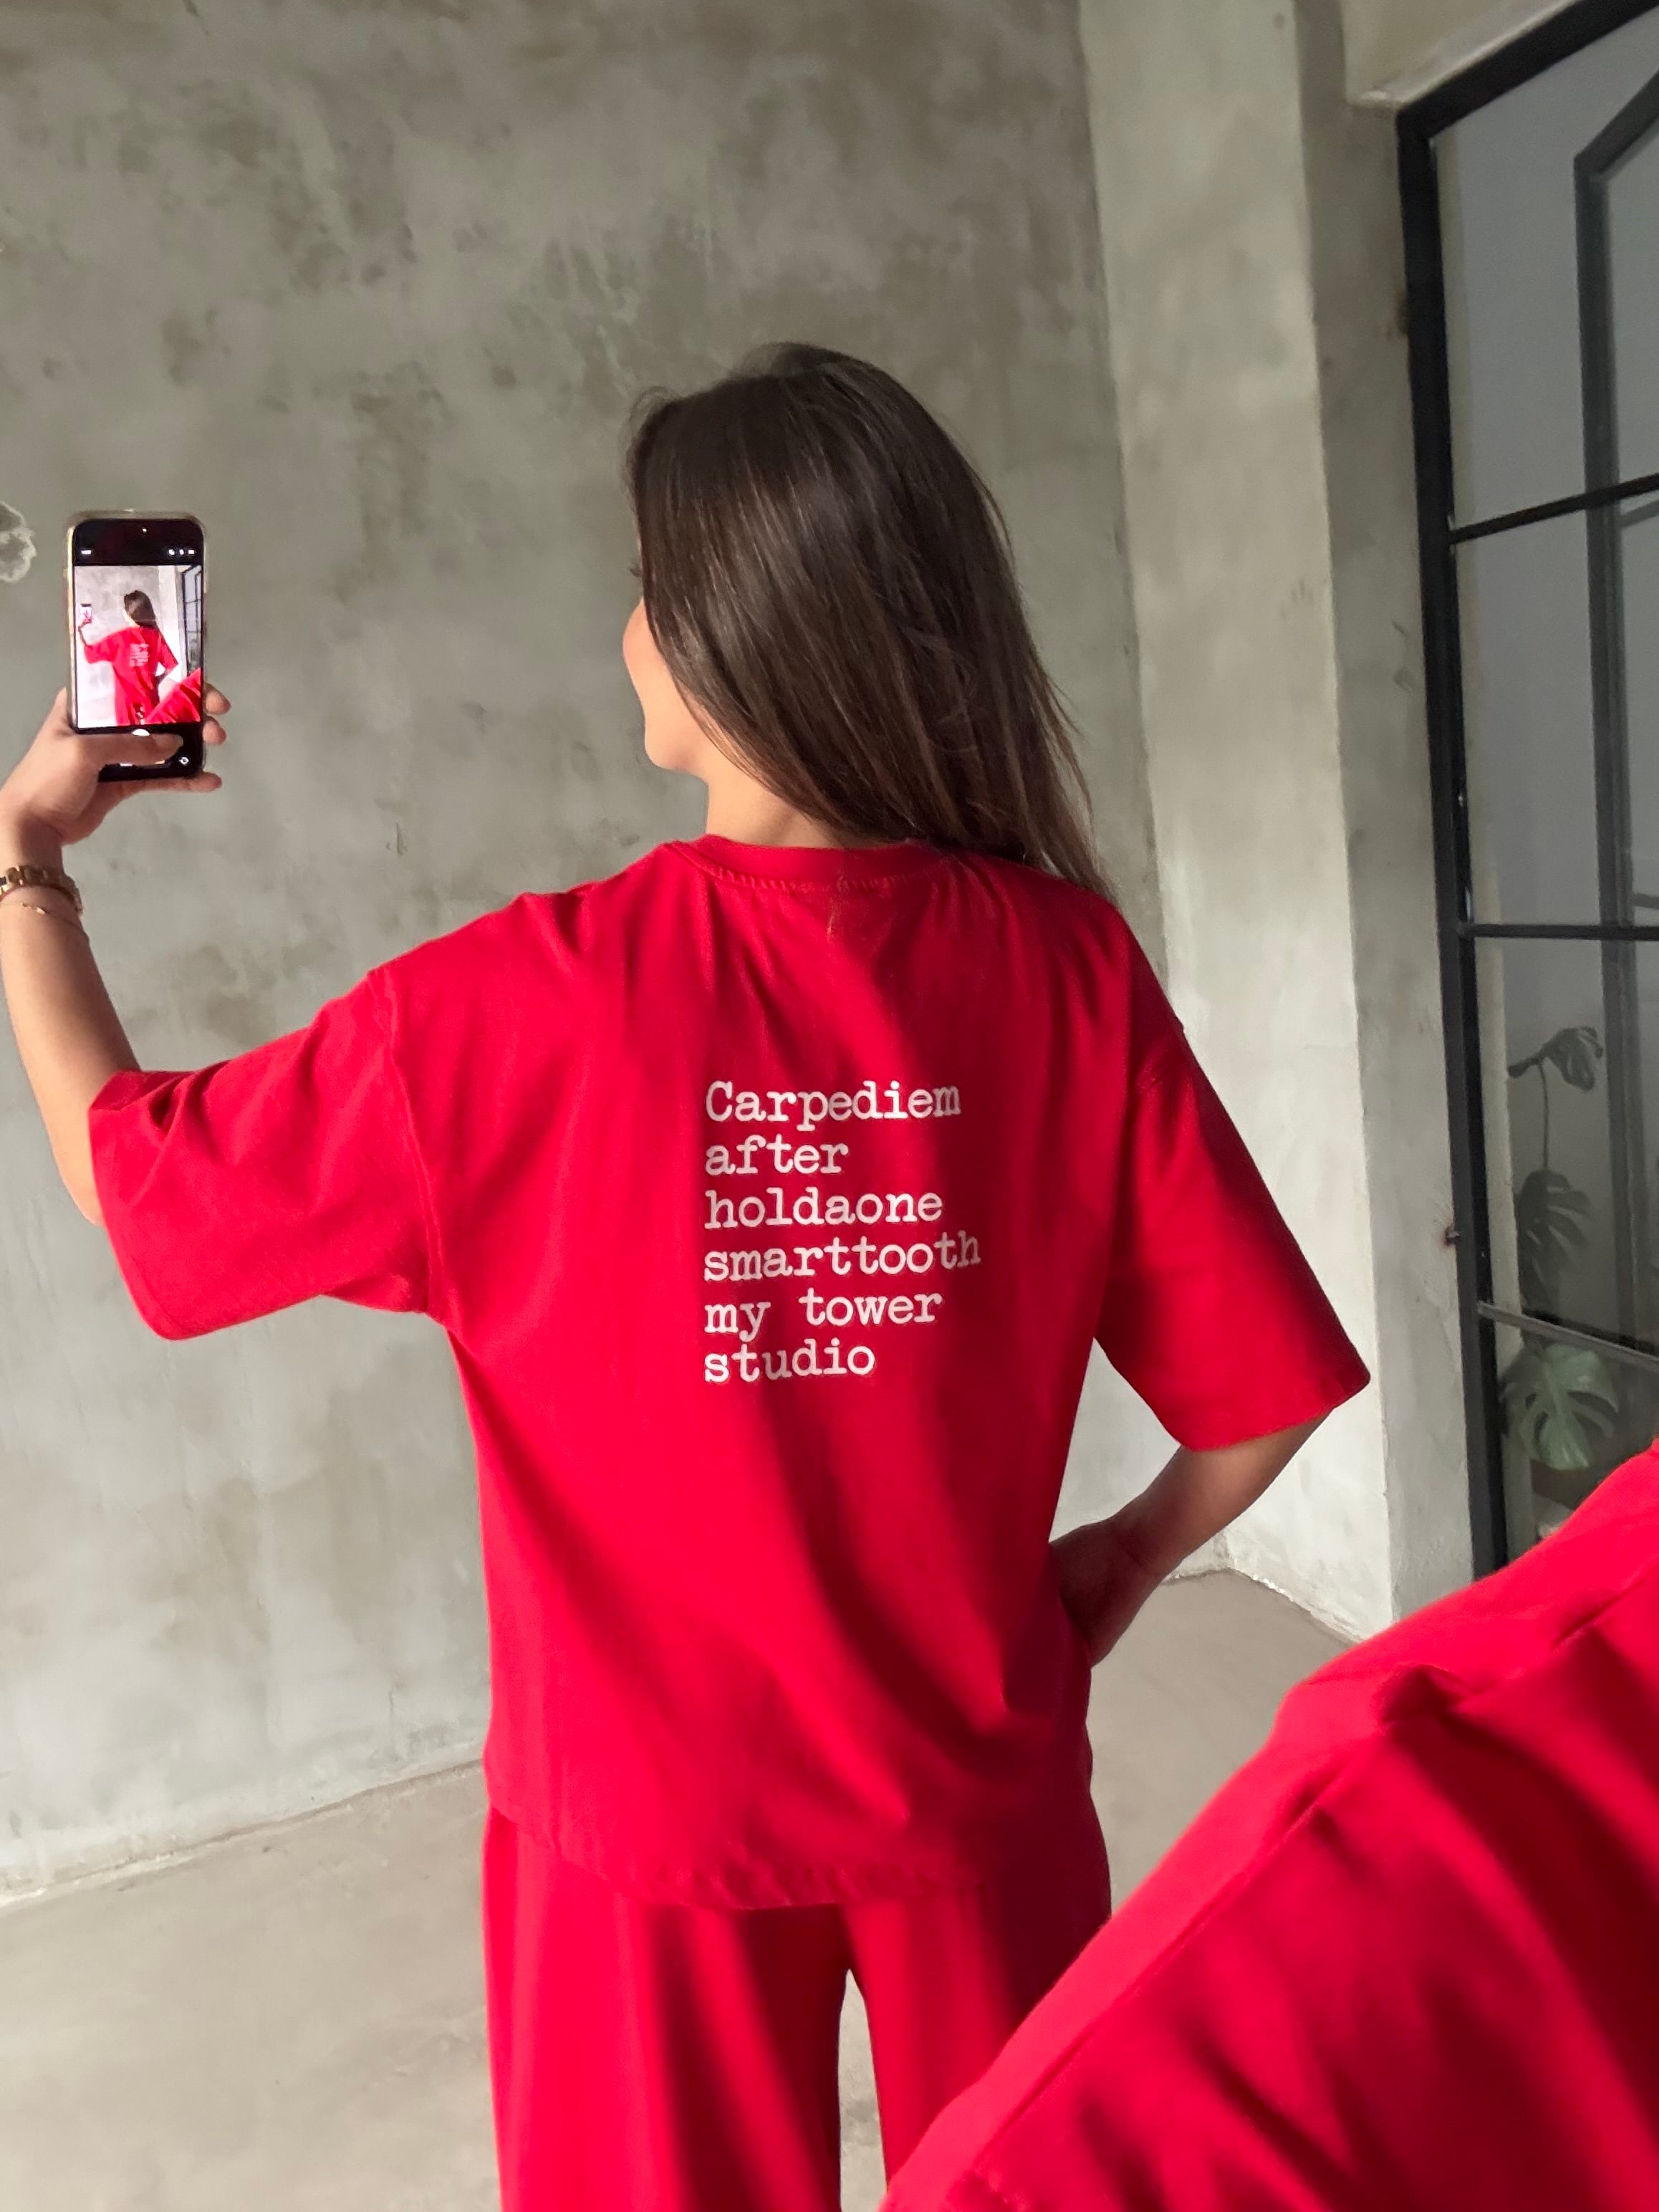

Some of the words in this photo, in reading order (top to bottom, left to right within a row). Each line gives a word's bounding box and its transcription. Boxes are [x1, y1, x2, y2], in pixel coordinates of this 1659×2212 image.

[706, 1080, 961, 1132] Carpediem
[705, 1133, 849, 1175] after
[704, 1186, 943, 1229] holdaone
[704, 1230, 981, 1281] smarttooth
[704, 1302, 771, 1342] my
[798, 1287, 943, 1327] tower
[704, 1337, 876, 1382] studio
